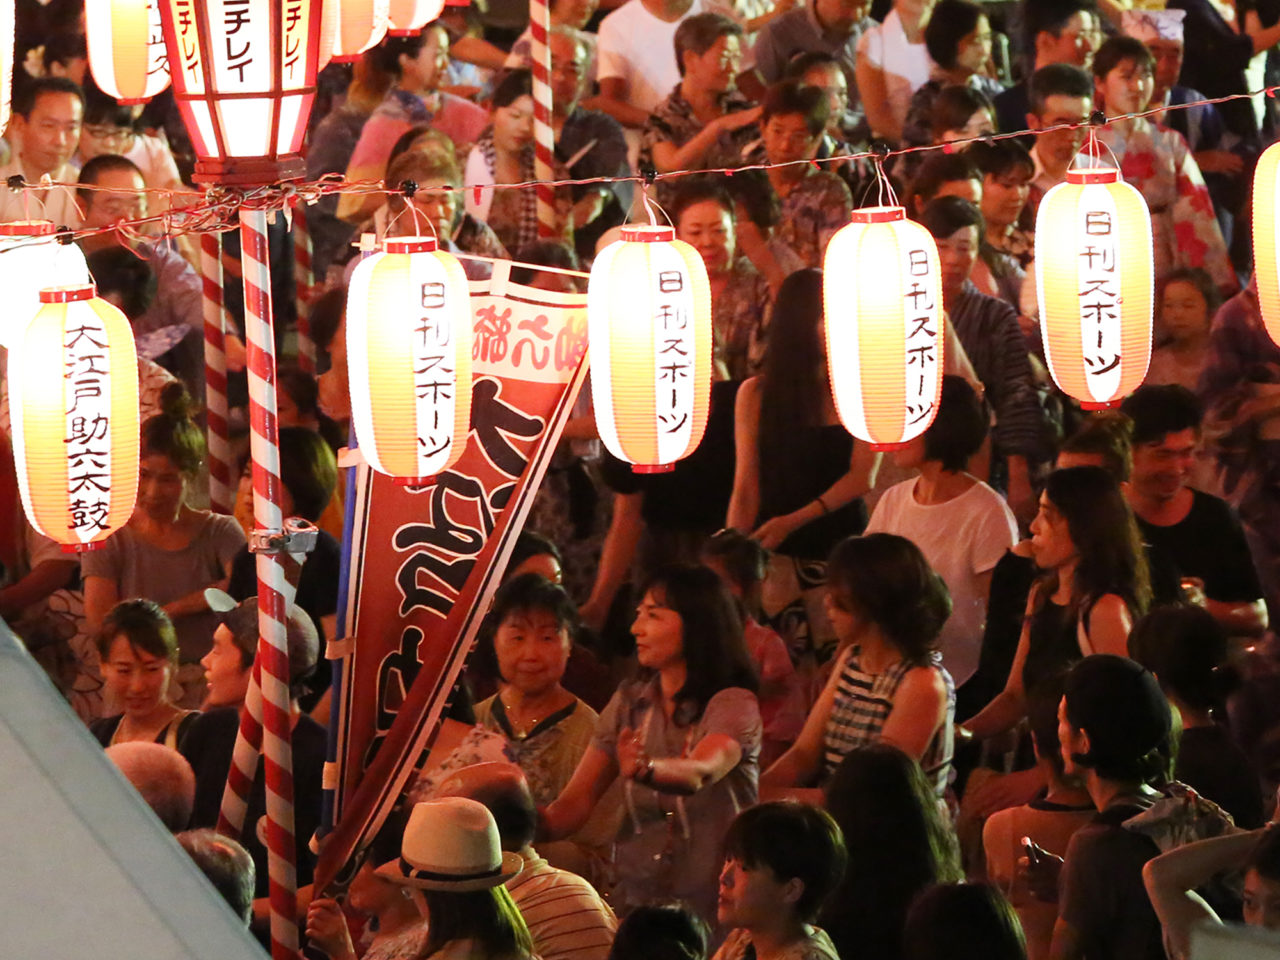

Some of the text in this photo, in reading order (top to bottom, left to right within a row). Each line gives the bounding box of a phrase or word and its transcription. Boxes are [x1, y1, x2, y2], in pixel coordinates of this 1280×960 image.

[413, 281, 457, 458] 日刊スポーツ
[656, 270, 693, 434] 日刊スポーツ
[904, 249, 939, 426] 日刊スポーツ
[1078, 210, 1125, 376] 日刊スポーツ
[63, 324, 112, 532] 大江戸助六太鼓
